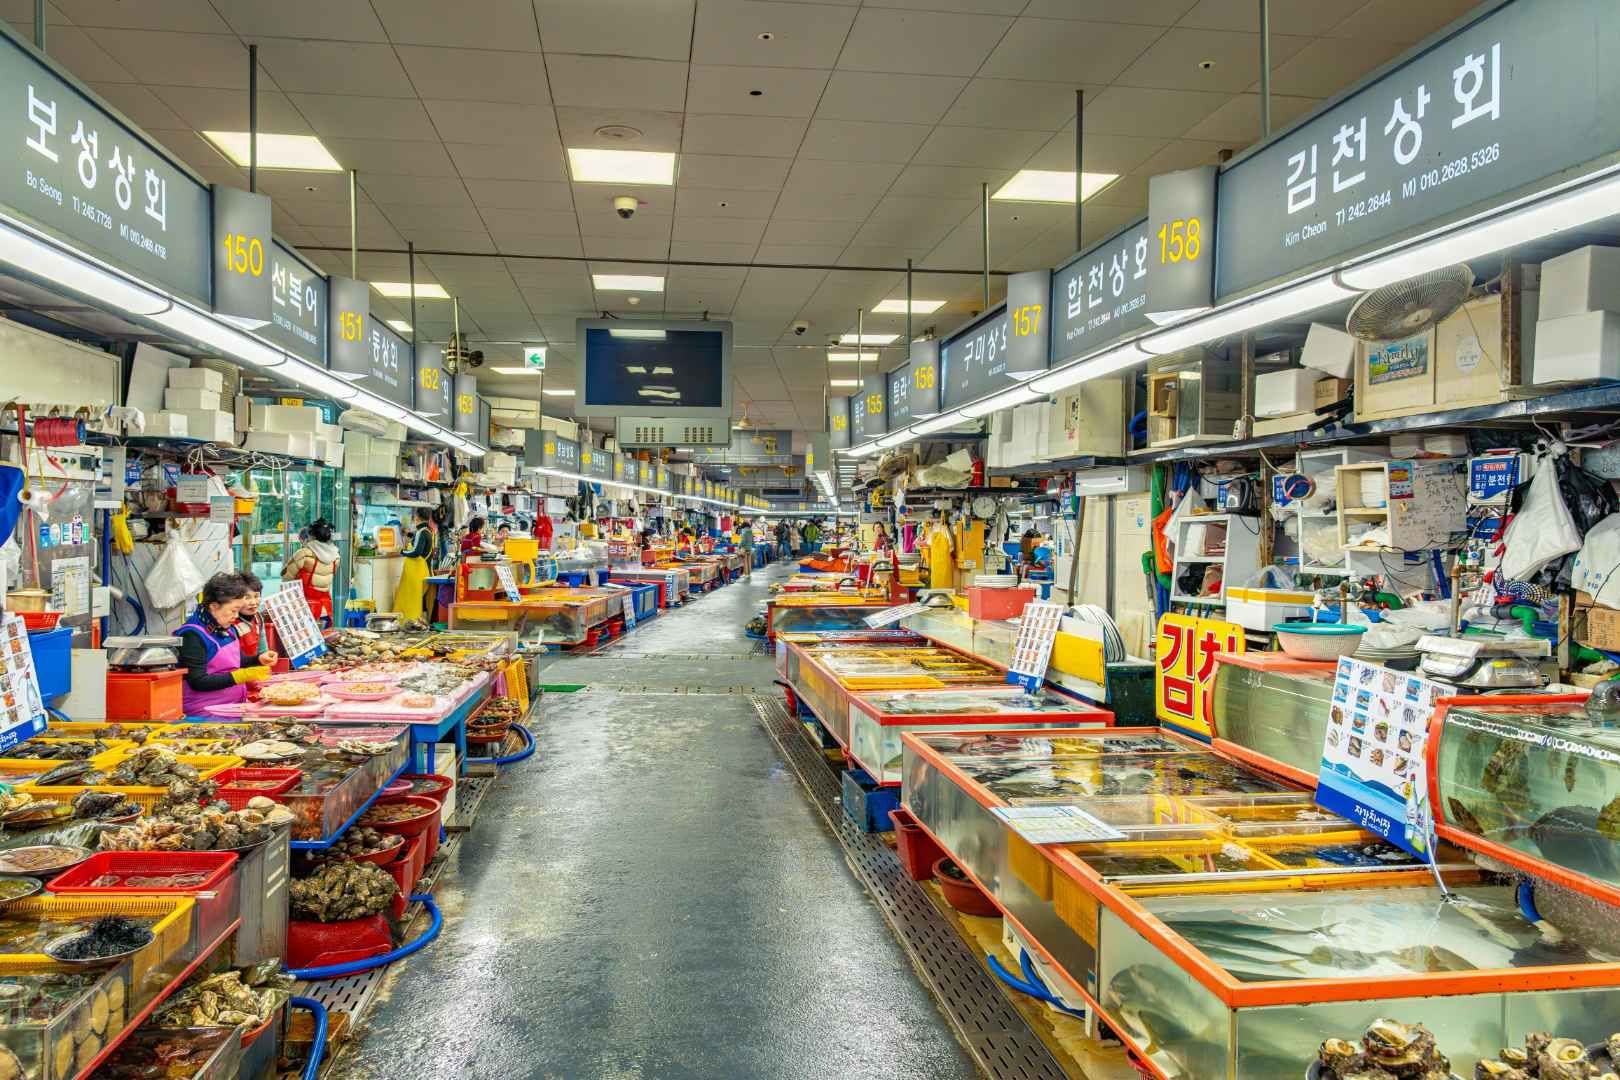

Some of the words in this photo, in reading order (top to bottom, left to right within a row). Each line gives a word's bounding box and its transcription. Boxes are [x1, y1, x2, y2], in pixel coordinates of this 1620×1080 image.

[1286, 42, 1500, 215] 김천상회
[26, 84, 166, 231] 보성상회
[26, 170, 38, 188] Bo
[39, 177, 62, 205] Seong
[1285, 230, 1299, 247] Kim
[1302, 221, 1327, 241] Cheon
[1347, 190, 1391, 221] 242.2844
[1402, 178, 1417, 199] M)
[1420, 142, 1500, 191] 010.2628.5326
[224, 232, 264, 277] 150
[1157, 218, 1201, 264] 158
[340, 311, 363, 343] 151
[1013, 304, 1041, 337] 157
[420, 367, 439, 391] 152
[914, 365, 935, 390] 156
[1354, 804, 1391, 837] 자갈치시장
